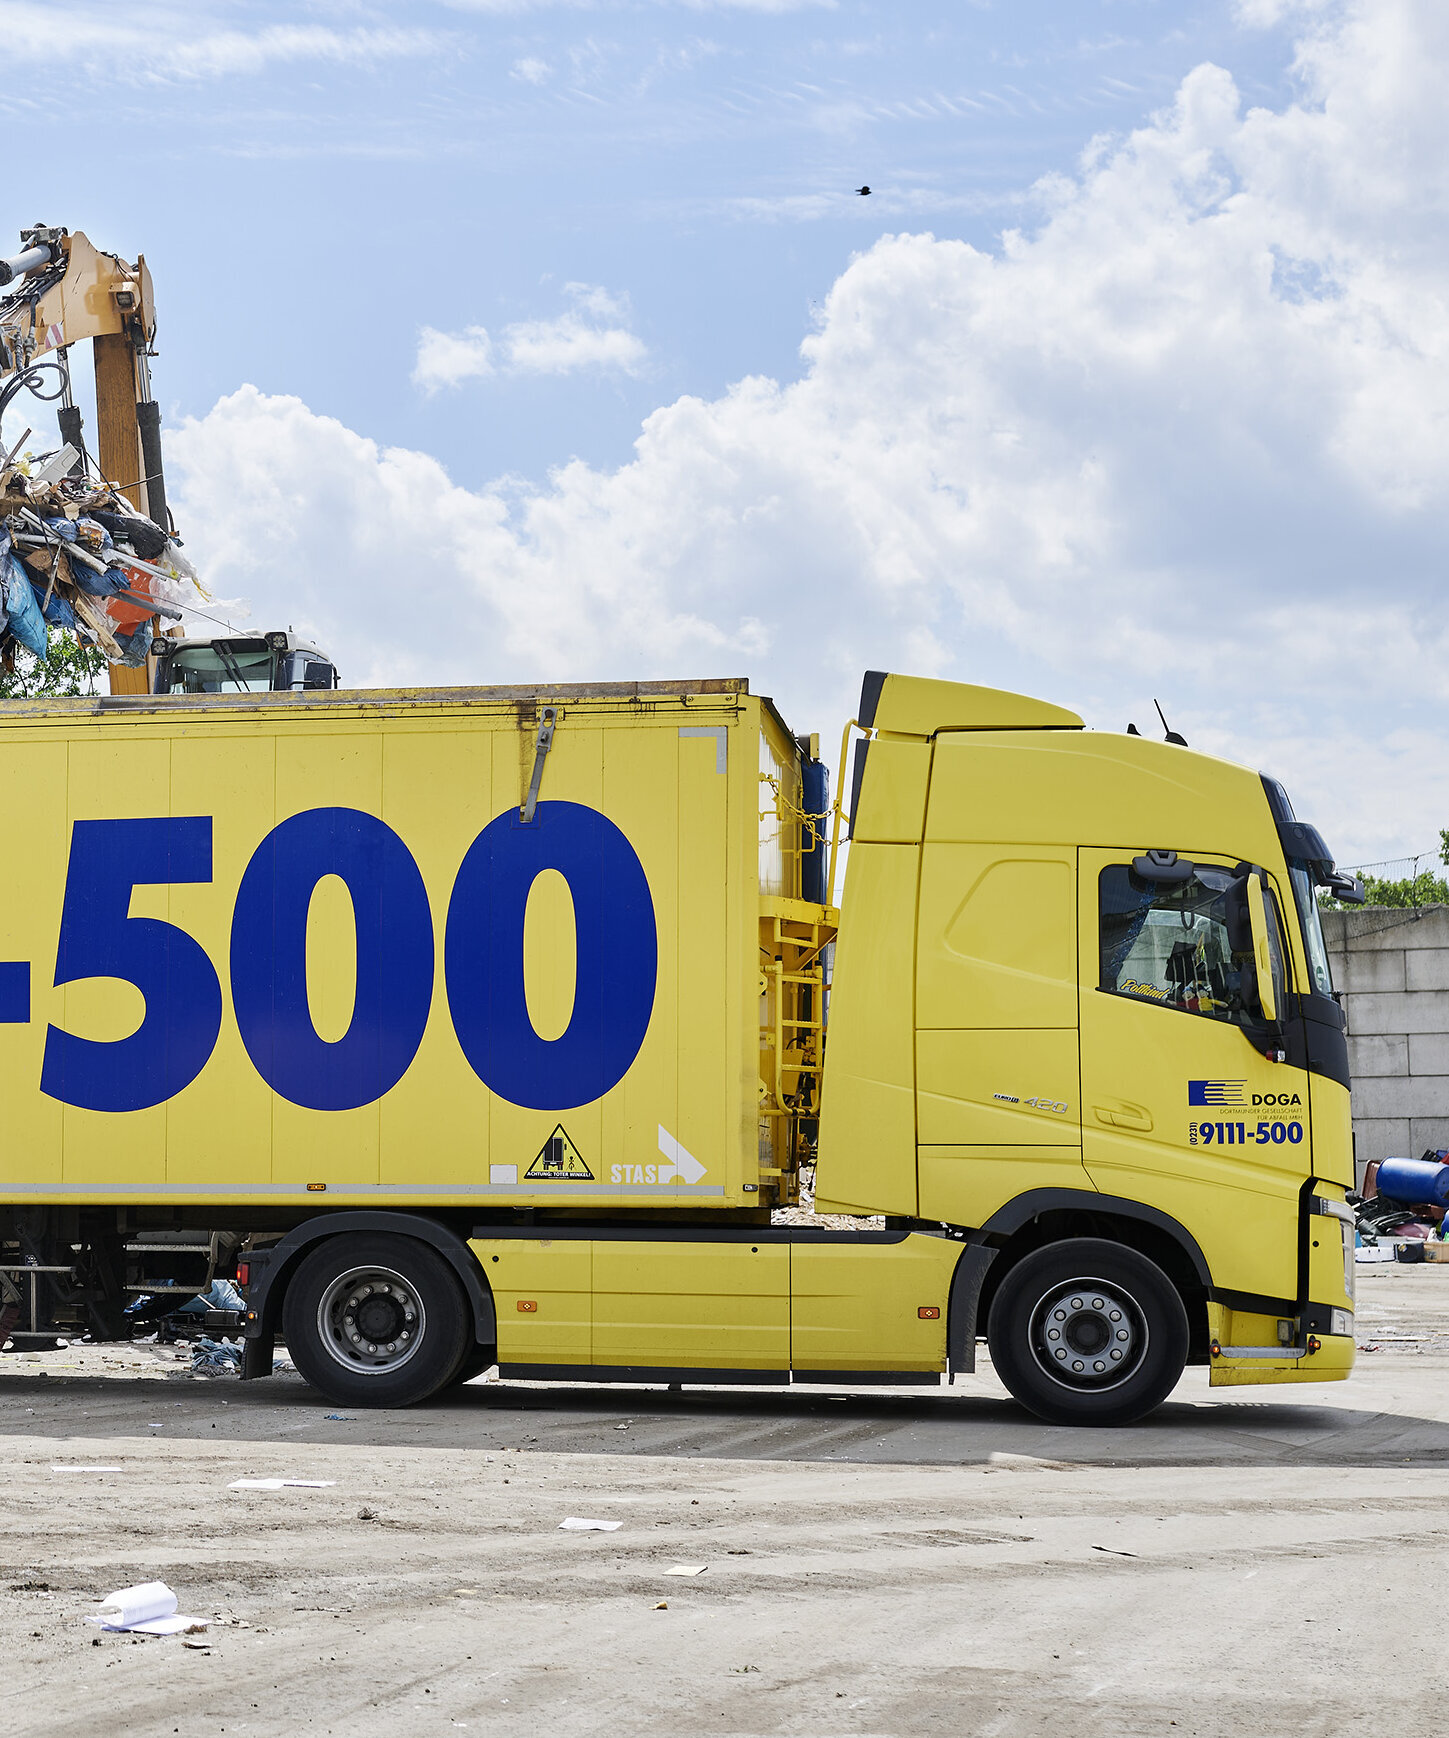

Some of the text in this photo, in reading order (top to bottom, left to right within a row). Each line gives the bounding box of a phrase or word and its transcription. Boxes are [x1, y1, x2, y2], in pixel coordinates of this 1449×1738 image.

[1024, 1097, 1068, 1113] 420
[1251, 1093, 1302, 1106] DOGA
[1188, 1122, 1199, 1146] (0231)
[1199, 1121, 1304, 1145] 9111-500
[610, 1164, 657, 1184] STAS
